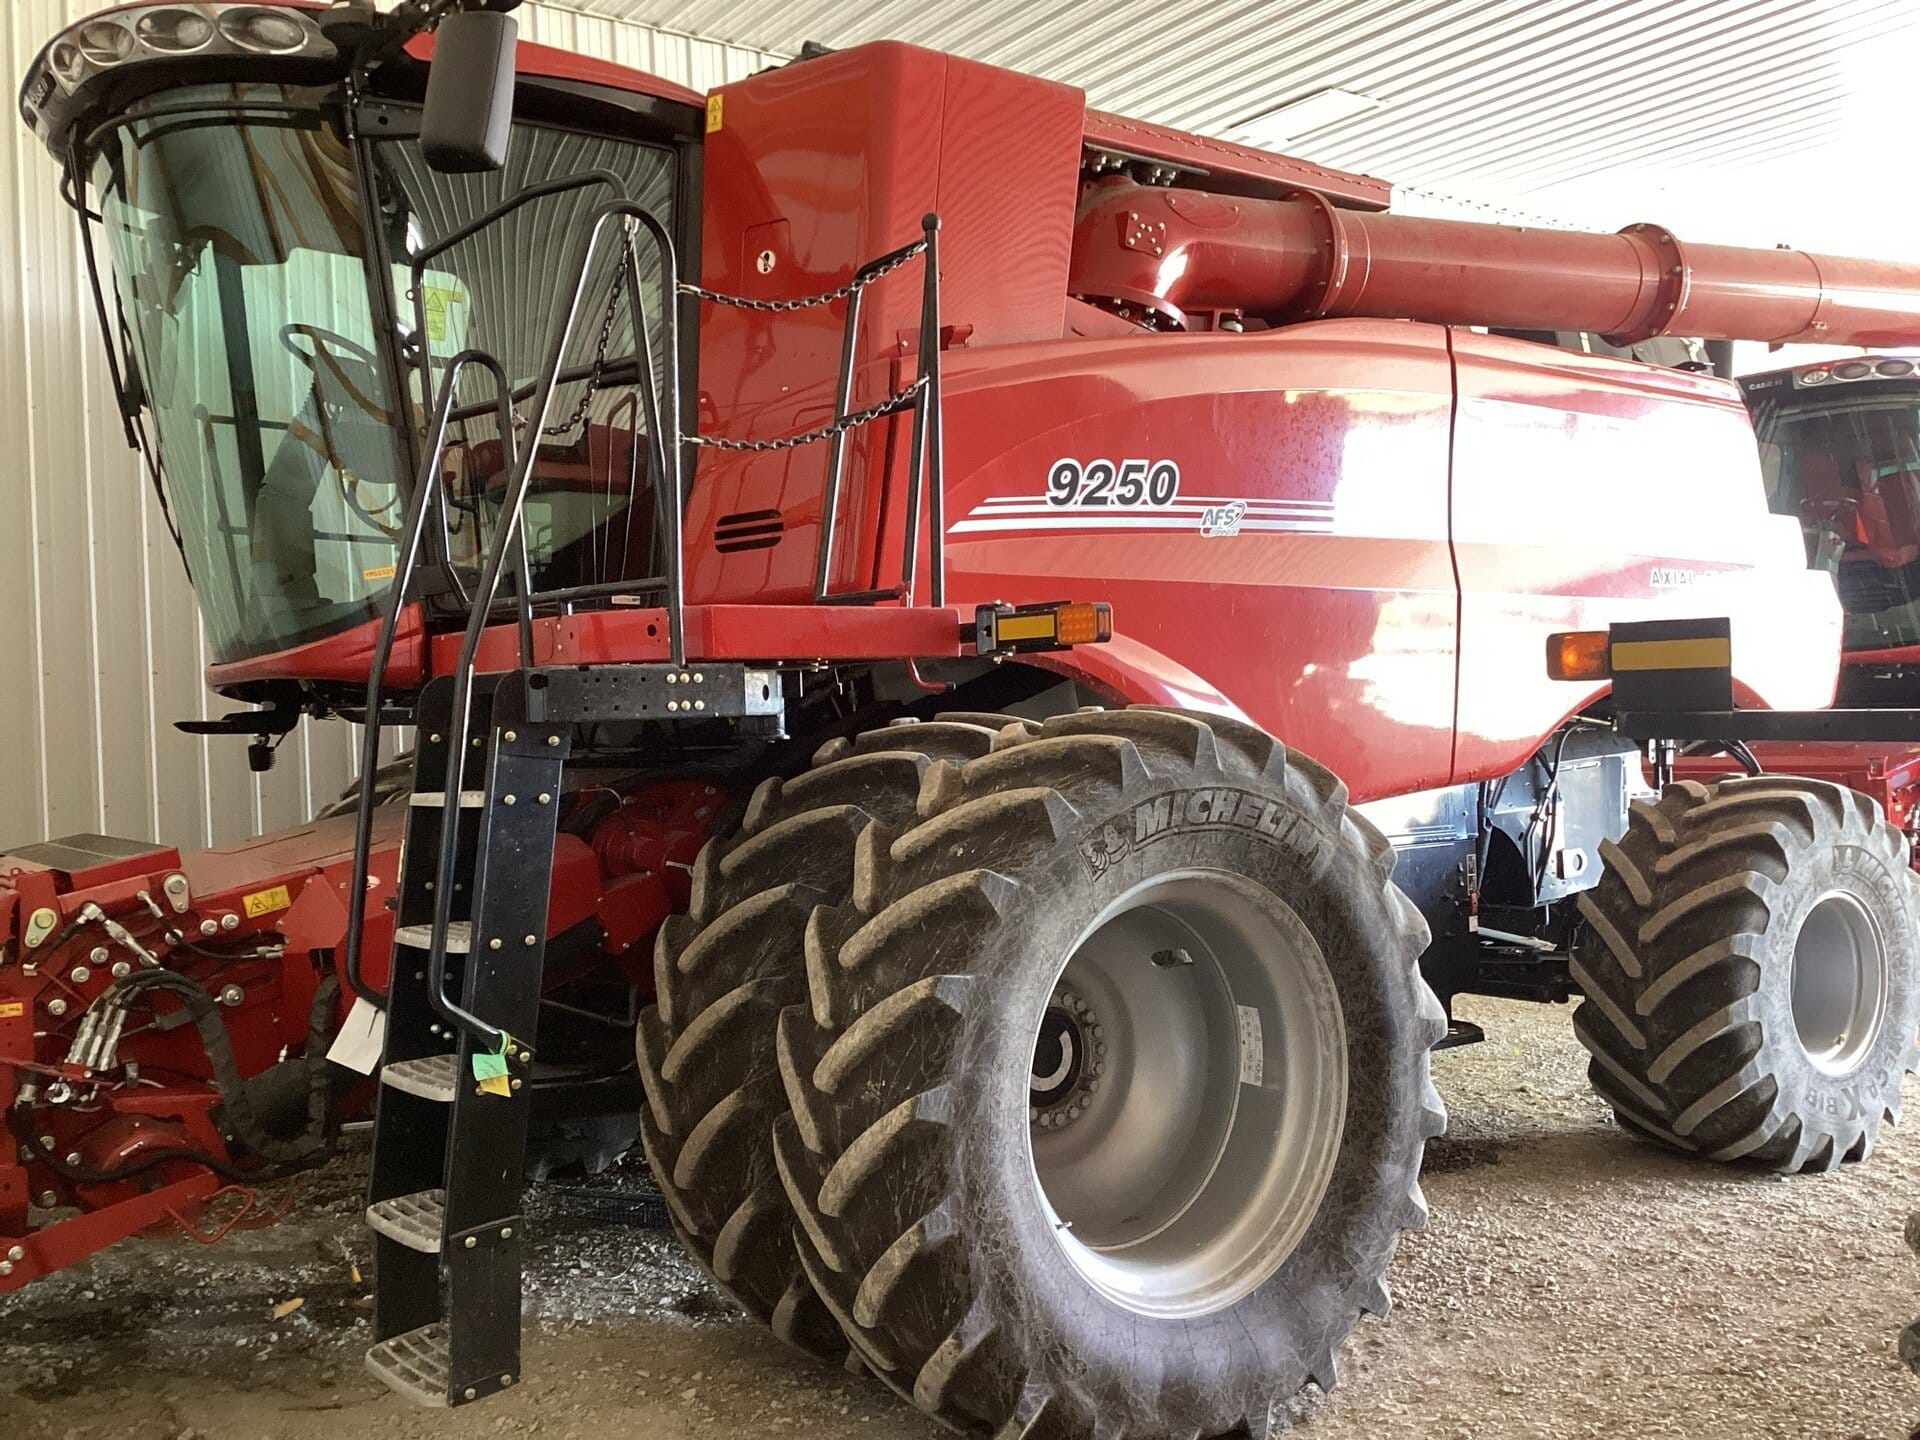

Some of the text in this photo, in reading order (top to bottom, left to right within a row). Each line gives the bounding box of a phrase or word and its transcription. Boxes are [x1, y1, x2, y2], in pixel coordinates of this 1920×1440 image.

[1048, 460, 1178, 507] 9250
[1201, 508, 1235, 526] AFS
[1135, 790, 1321, 873] MICHELIN
